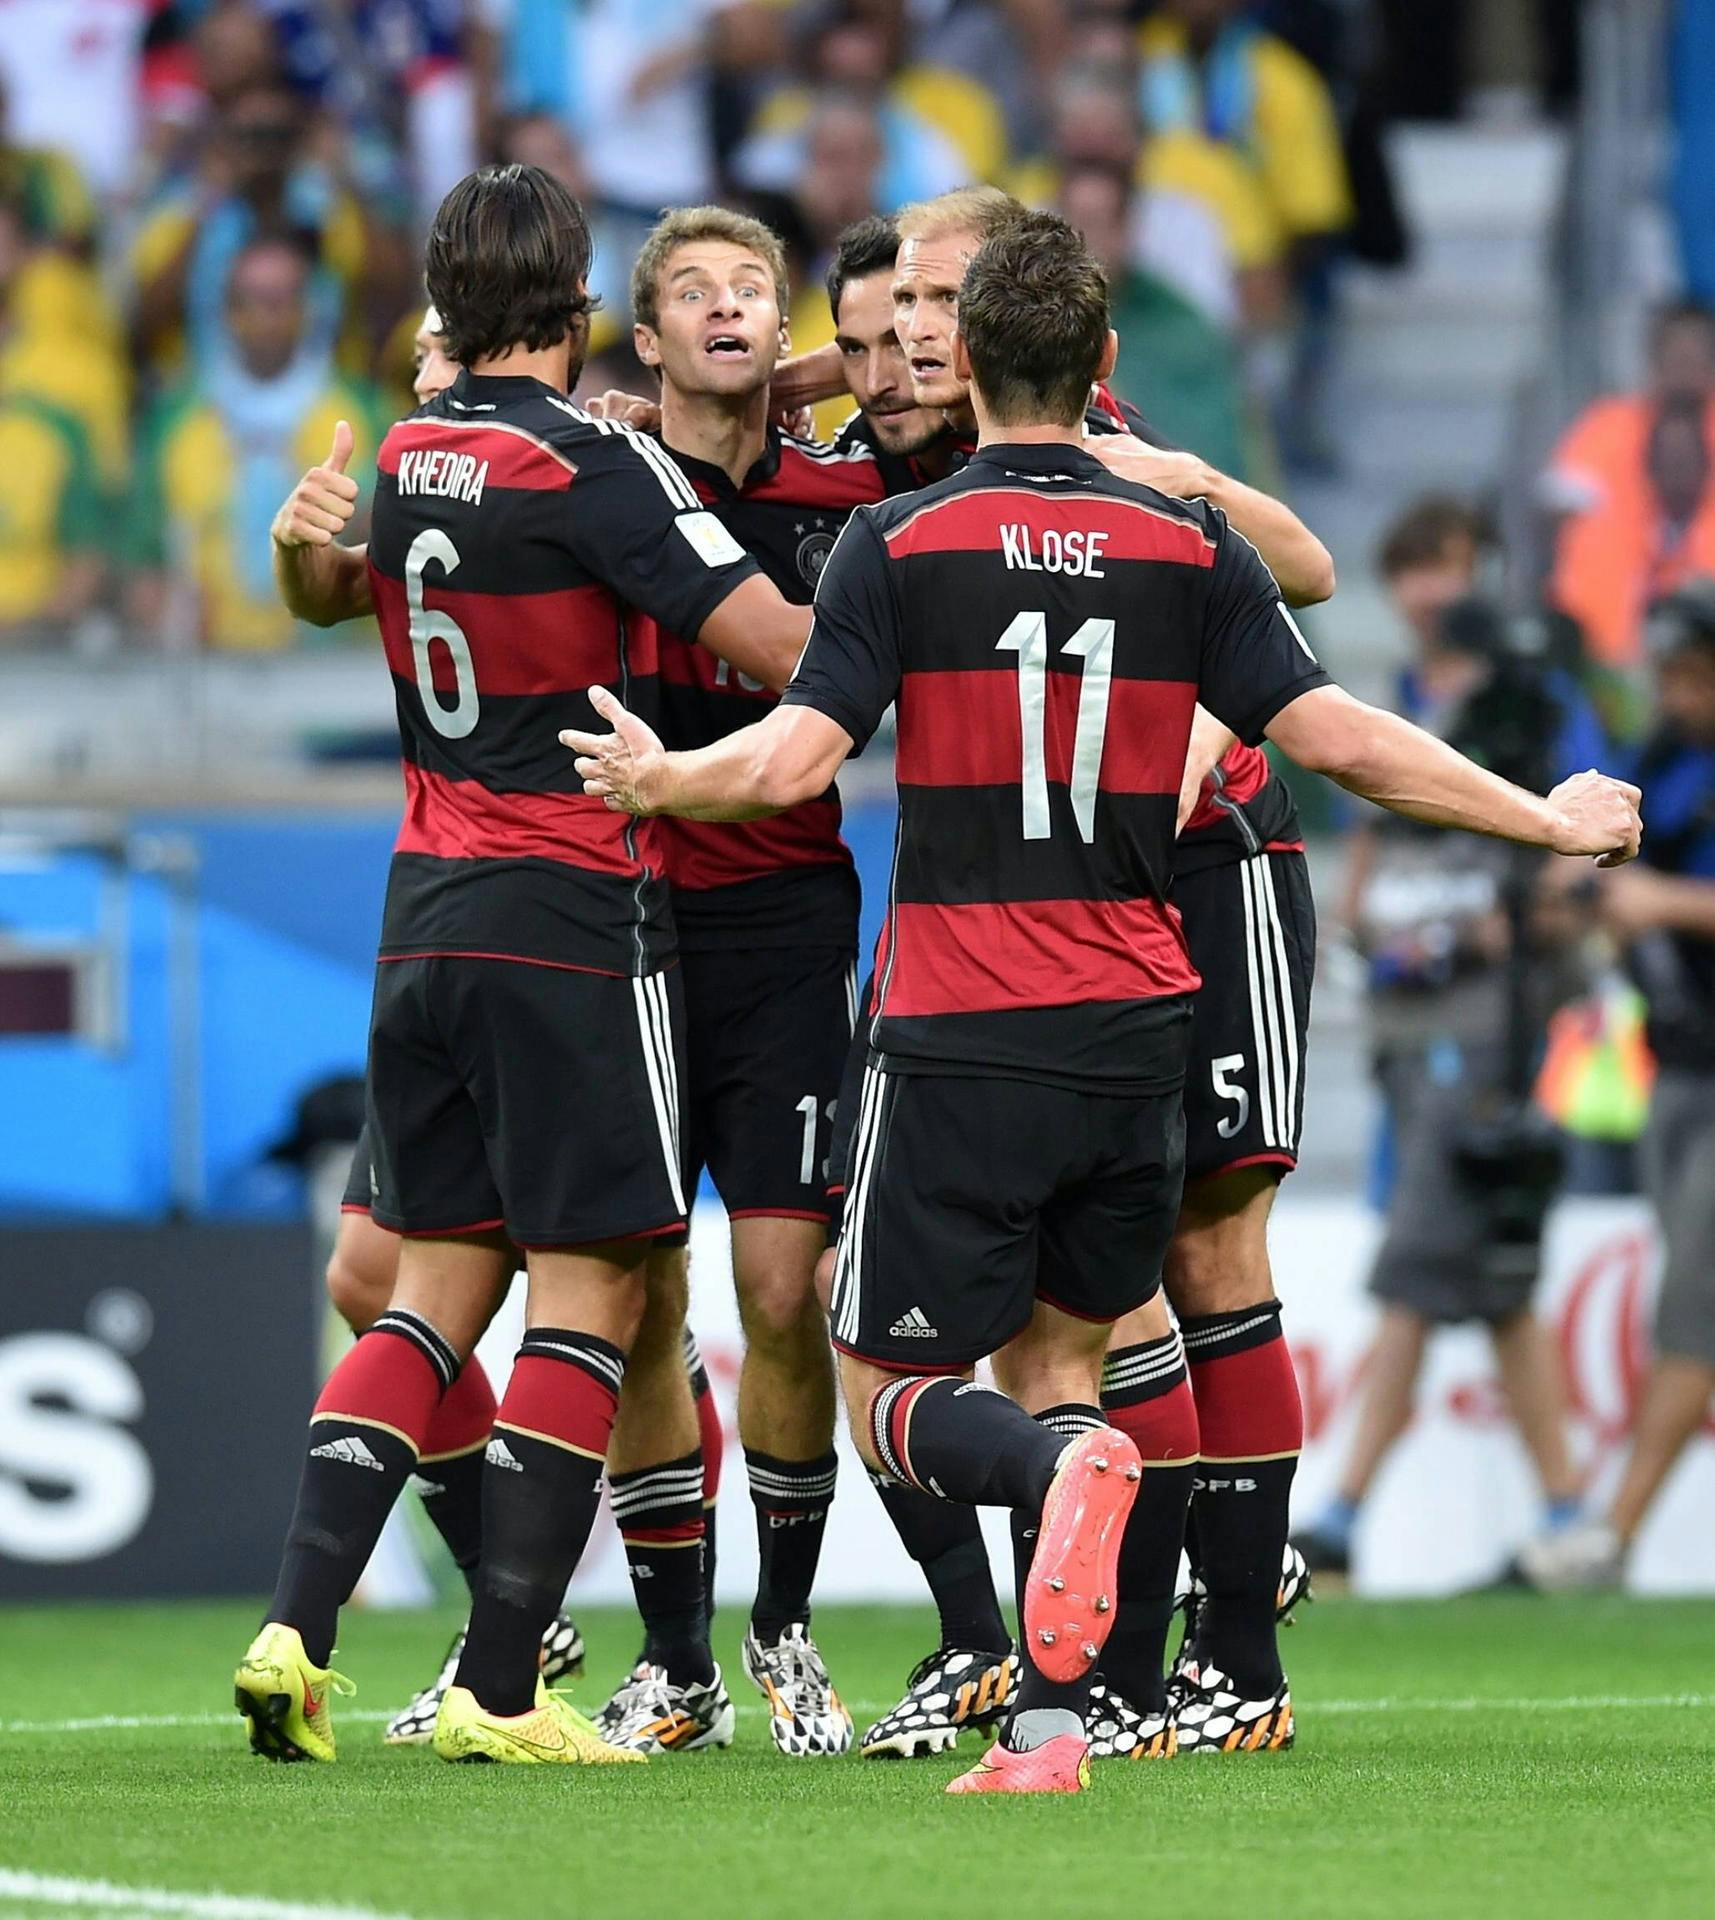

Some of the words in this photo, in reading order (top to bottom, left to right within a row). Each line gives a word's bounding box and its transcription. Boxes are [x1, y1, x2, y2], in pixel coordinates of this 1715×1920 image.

[397, 450, 489, 506] KHEDIRA
[999, 524, 1109, 578] KLOSE
[405, 528, 480, 739] 6
[995, 611, 1115, 844] 11
[795, 1094, 838, 1184] 1
[1211, 1053, 1249, 1139] 5
